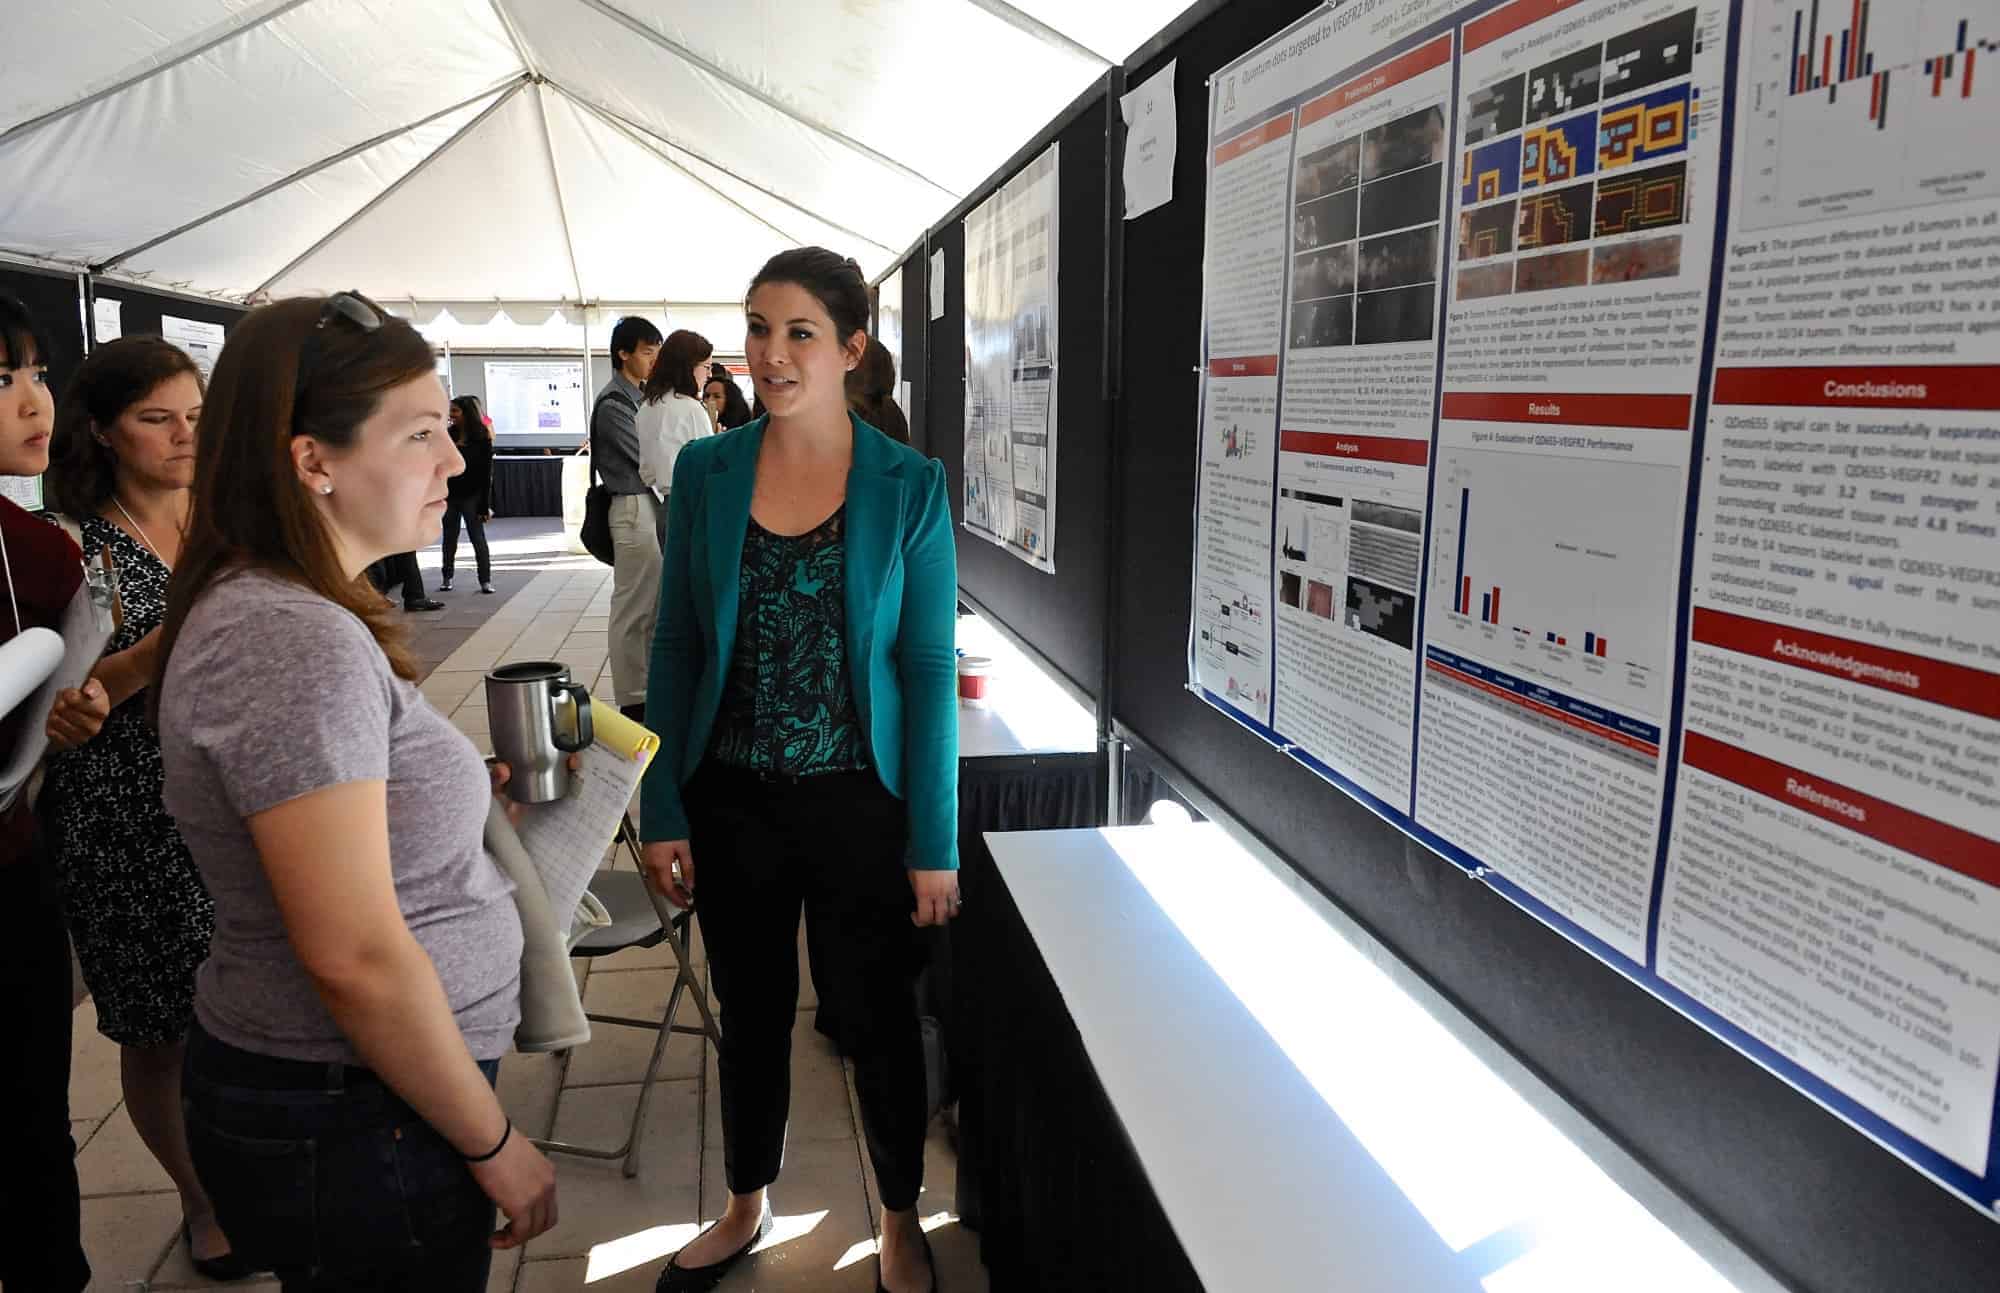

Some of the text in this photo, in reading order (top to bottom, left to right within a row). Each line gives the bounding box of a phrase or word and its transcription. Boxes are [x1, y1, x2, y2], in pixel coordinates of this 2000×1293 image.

[1288, 30, 1322, 56] targeted
[1323, 25, 1331, 38] to
[1333, 9, 1363, 33] VEGFR2
[1528, 402, 1561, 416] Results
[1823, 380, 1927, 398] Conclusions
[1773, 639, 1920, 688] Acknowledgements
[1785, 777, 1866, 821] References
